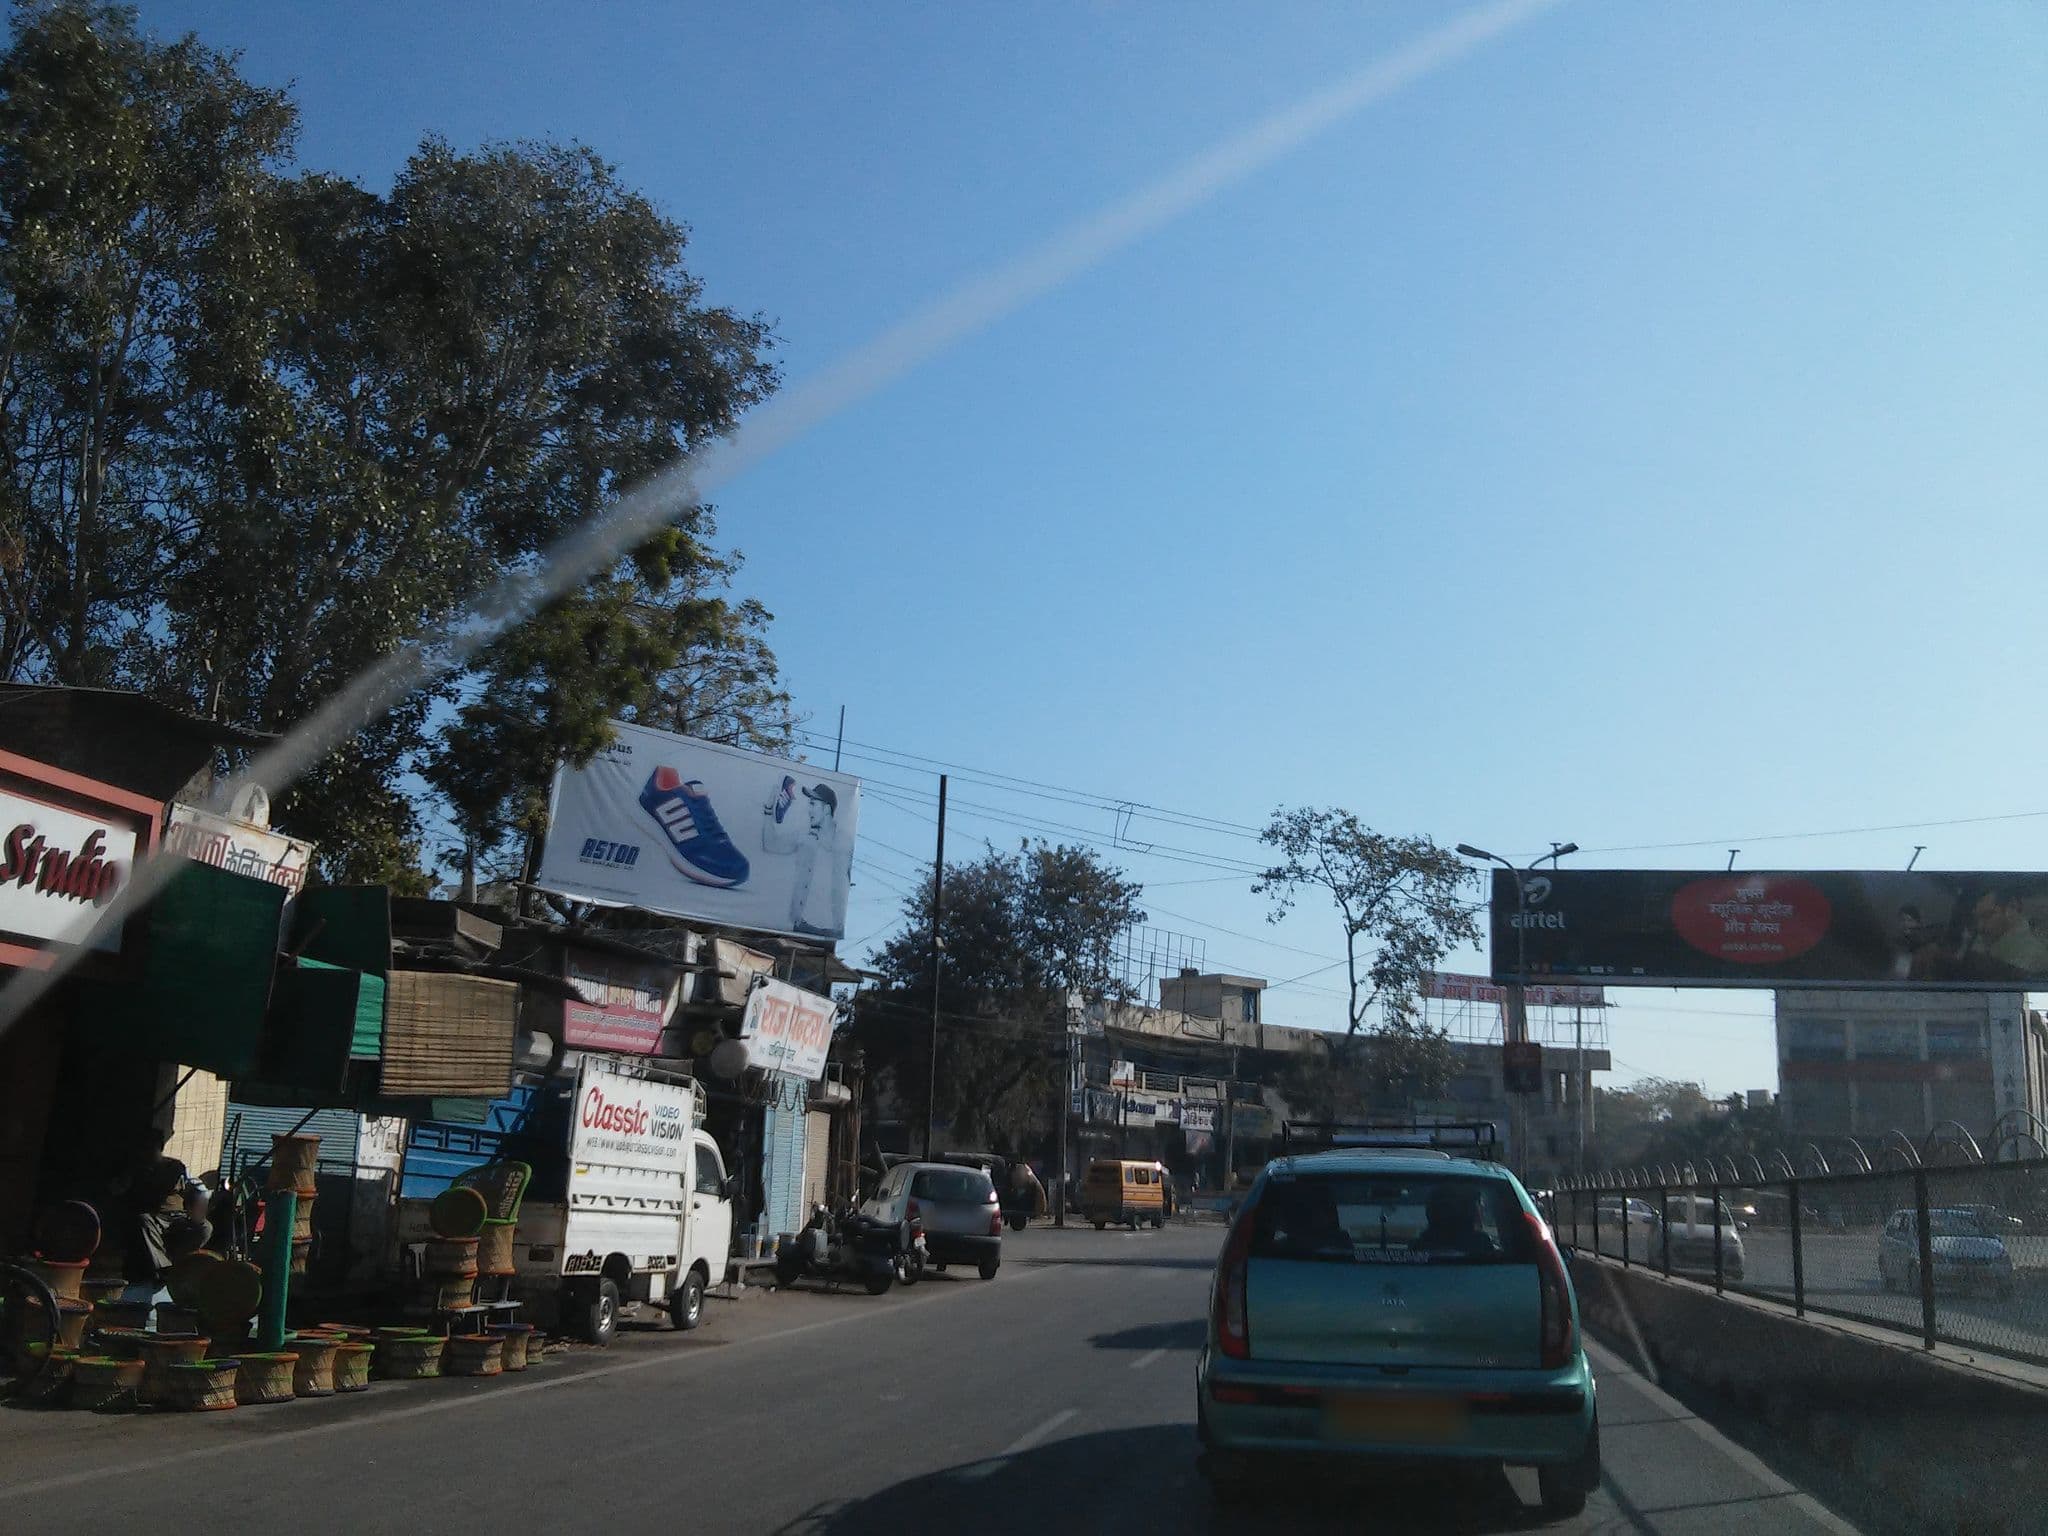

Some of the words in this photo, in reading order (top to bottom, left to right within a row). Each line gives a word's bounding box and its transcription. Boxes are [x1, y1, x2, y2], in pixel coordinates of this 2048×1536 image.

[0, 824, 121, 907] Studio
[1510, 911, 1567, 929] airtel
[582, 1085, 650, 1136] Classic
[654, 1103, 680, 1119] VIDEO
[651, 1119, 685, 1141] VISION
